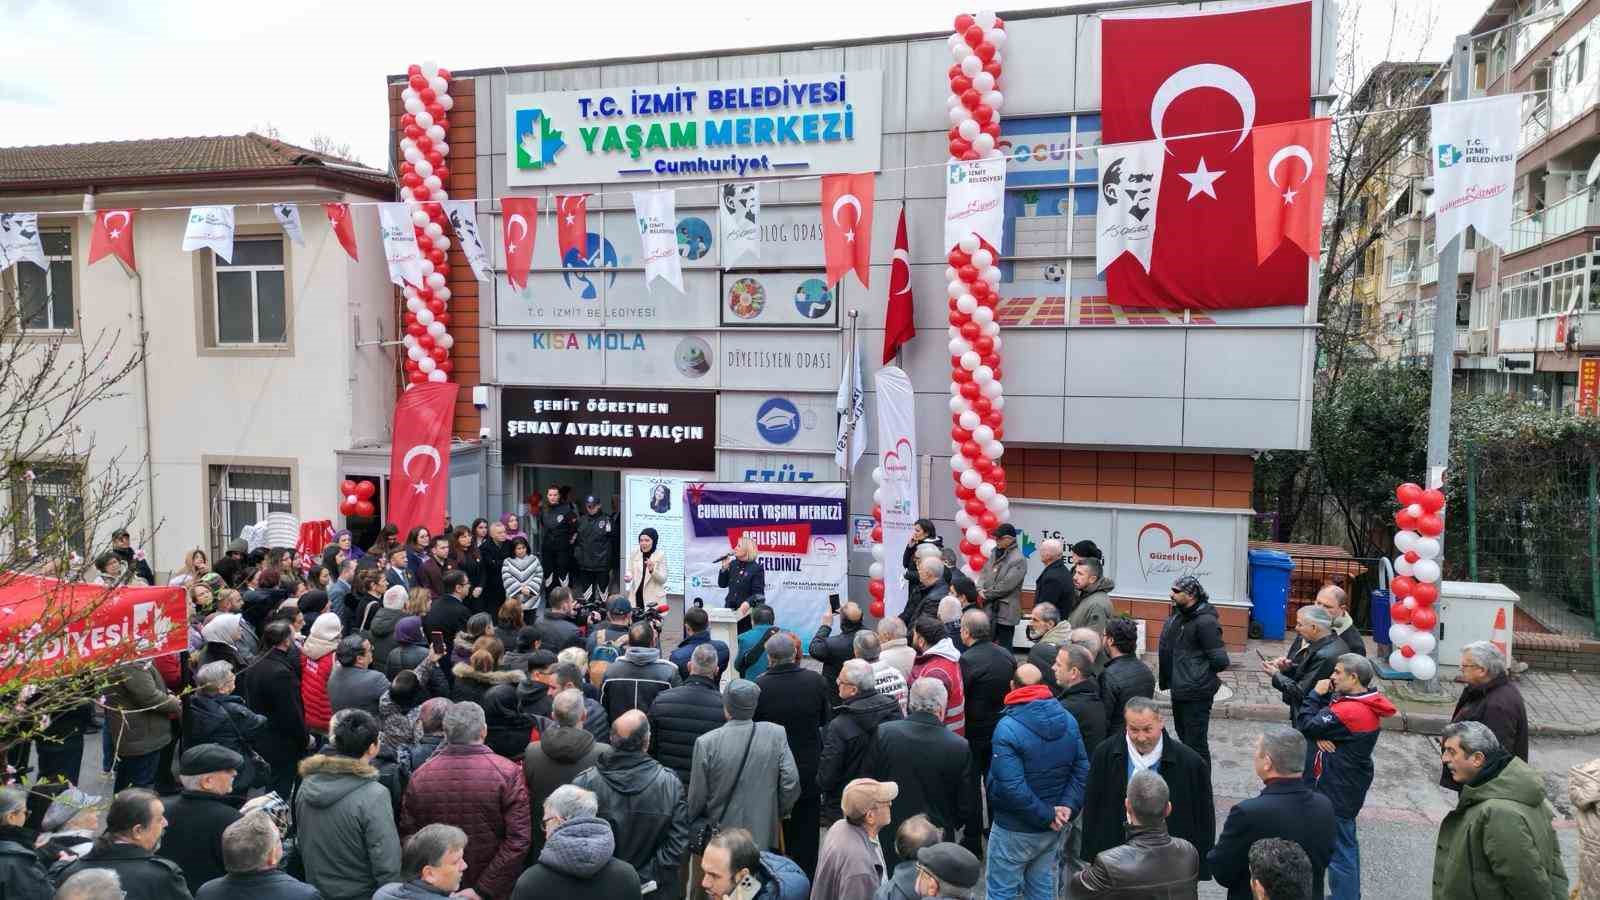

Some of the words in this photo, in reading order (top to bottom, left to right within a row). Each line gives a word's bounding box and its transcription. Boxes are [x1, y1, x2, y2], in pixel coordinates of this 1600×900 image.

[578, 97, 623, 118] T.C.
[631, 86, 697, 115] İZMİT
[708, 74, 846, 112] BELEDİYESİ
[579, 121, 697, 159] YAŞAM
[705, 104, 853, 147] MERKEZİ
[654, 154, 769, 176] Cumhuriyet
[1466, 154, 1513, 163] BELEDİYESİ
[793, 224, 823, 242] ODAS
[532, 332, 579, 350] KISA
[587, 332, 646, 350] MOLA
[797, 351, 831, 369] ODASI
[533, 398, 579, 413] ŞEHİT
[587, 398, 669, 414] ÖĞRETMEN
[507, 420, 561, 437] ŞENAY
[565, 421, 633, 438] AYBÜKE
[637, 424, 704, 443] YALÇIN
[574, 445, 632, 457] ANISINA
[697, 501, 760, 519] CUMHURİYET
[761, 504, 797, 522] YAŞAM
[799, 502, 843, 520] MERKEZİ
[1041, 530, 1065, 540] T.C.
[1150, 552, 1175, 561] Güzel
